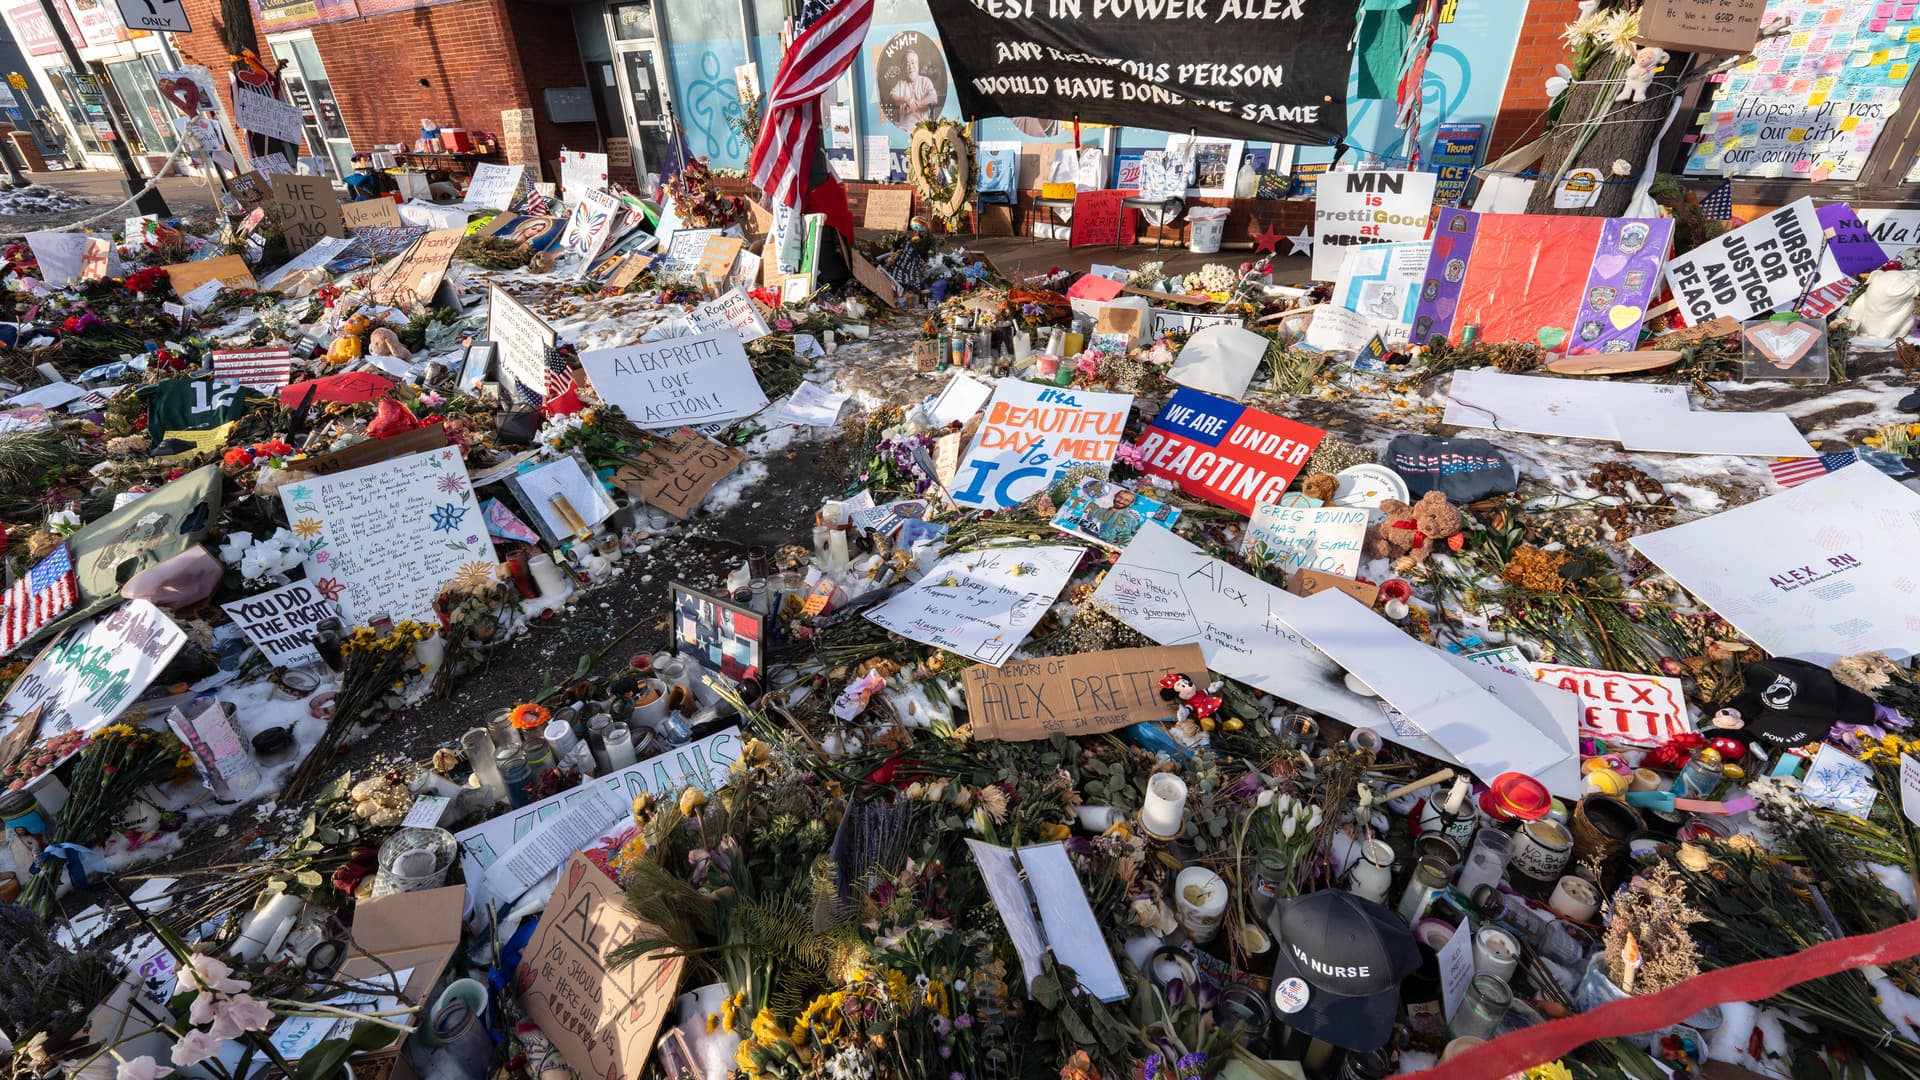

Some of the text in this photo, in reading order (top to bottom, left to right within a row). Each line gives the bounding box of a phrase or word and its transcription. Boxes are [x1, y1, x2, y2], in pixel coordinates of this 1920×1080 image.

[1216, 0, 1305, 21] ALEX
[1715, 12, 1734, 21] GOOD
[141, 17, 171, 27] ONLY
[1178, 63, 1283, 88] PERSON
[973, 76, 1321, 124] WOULD HAVE DONE SAME
[1737, 97, 1882, 123] Hopes pryers
[1760, 123, 1845, 143] our city,
[1446, 142, 1474, 153] TRUMP
[1723, 149, 1755, 163] our
[1346, 173, 1404, 194] MN
[1441, 167, 1464, 179] ICE
[287, 184, 314, 201] HE
[584, 187, 613, 209] TOGETHER
[1365, 194, 1382, 207] is
[1436, 190, 1460, 198] MAGA
[281, 203, 328, 220] DID
[347, 204, 391, 225] We will
[1084, 216, 1127, 227] SACRIFIE
[1323, 234, 1400, 247] MELTIN
[1360, 224, 1381, 236] at
[1772, 207, 1822, 287] NURSES
[1755, 238, 1789, 283] FOR
[1703, 263, 1737, 306] AND
[1722, 235, 1773, 314] JUSTICE
[1673, 261, 1717, 326] PEACE
[686, 294, 745, 327] Mr. Rogers,
[725, 303, 754, 321] Killing
[614, 338, 723, 376] ALEX PRETTI
[1369, 338, 1383, 357] NO
[648, 371, 693, 393] LOVE
[190, 381, 240, 414] 12
[672, 388, 686, 398] IN
[988, 401, 1123, 436] BEAUTIFUL
[1165, 403, 1309, 466] WE ARE UNDER
[980, 426, 1120, 466] DAY to MELT
[321, 459, 428, 496] All world
[1141, 432, 1287, 504] REACTING
[655, 469, 705, 507] ICE
[952, 459, 1066, 508] IC
[1259, 504, 1365, 525] GREG BOVINO
[1251, 528, 1360, 551] MIGHTY SMALL
[1270, 524, 1317, 537] HAS A
[975, 552, 1000, 569] We
[1769, 566, 1817, 587] ALEX
[1826, 553, 1857, 567] RN
[1119, 570, 1141, 586] Alex
[1187, 561, 1248, 608] Alex,
[1000, 584, 1018, 596] this
[1115, 583, 1141, 597] blood
[1155, 595, 1168, 603] on
[227, 587, 312, 623] YOU DID
[924, 605, 951, 617] We'll
[1111, 605, 1139, 617] this
[243, 601, 331, 639] THE RIGHT
[909, 619, 945, 635] Always
[1203, 621, 1233, 640] Trump
[972, 660, 1065, 681] IN MEMORY OF
[1558, 676, 1655, 705] ALEX
[981, 682, 1056, 723] ALEX
[1043, 713, 1129, 731] REST IN POWER
[1578, 706, 1677, 738] ETTI
[1762, 731, 1807, 742] POW MIA
[545, 937, 566, 965] YOU
[567, 960, 603, 1005] SHOULD
[1293, 944, 1370, 978] VA NURSE
[541, 963, 554, 982] BE
[556, 976, 581, 1010] HERE
